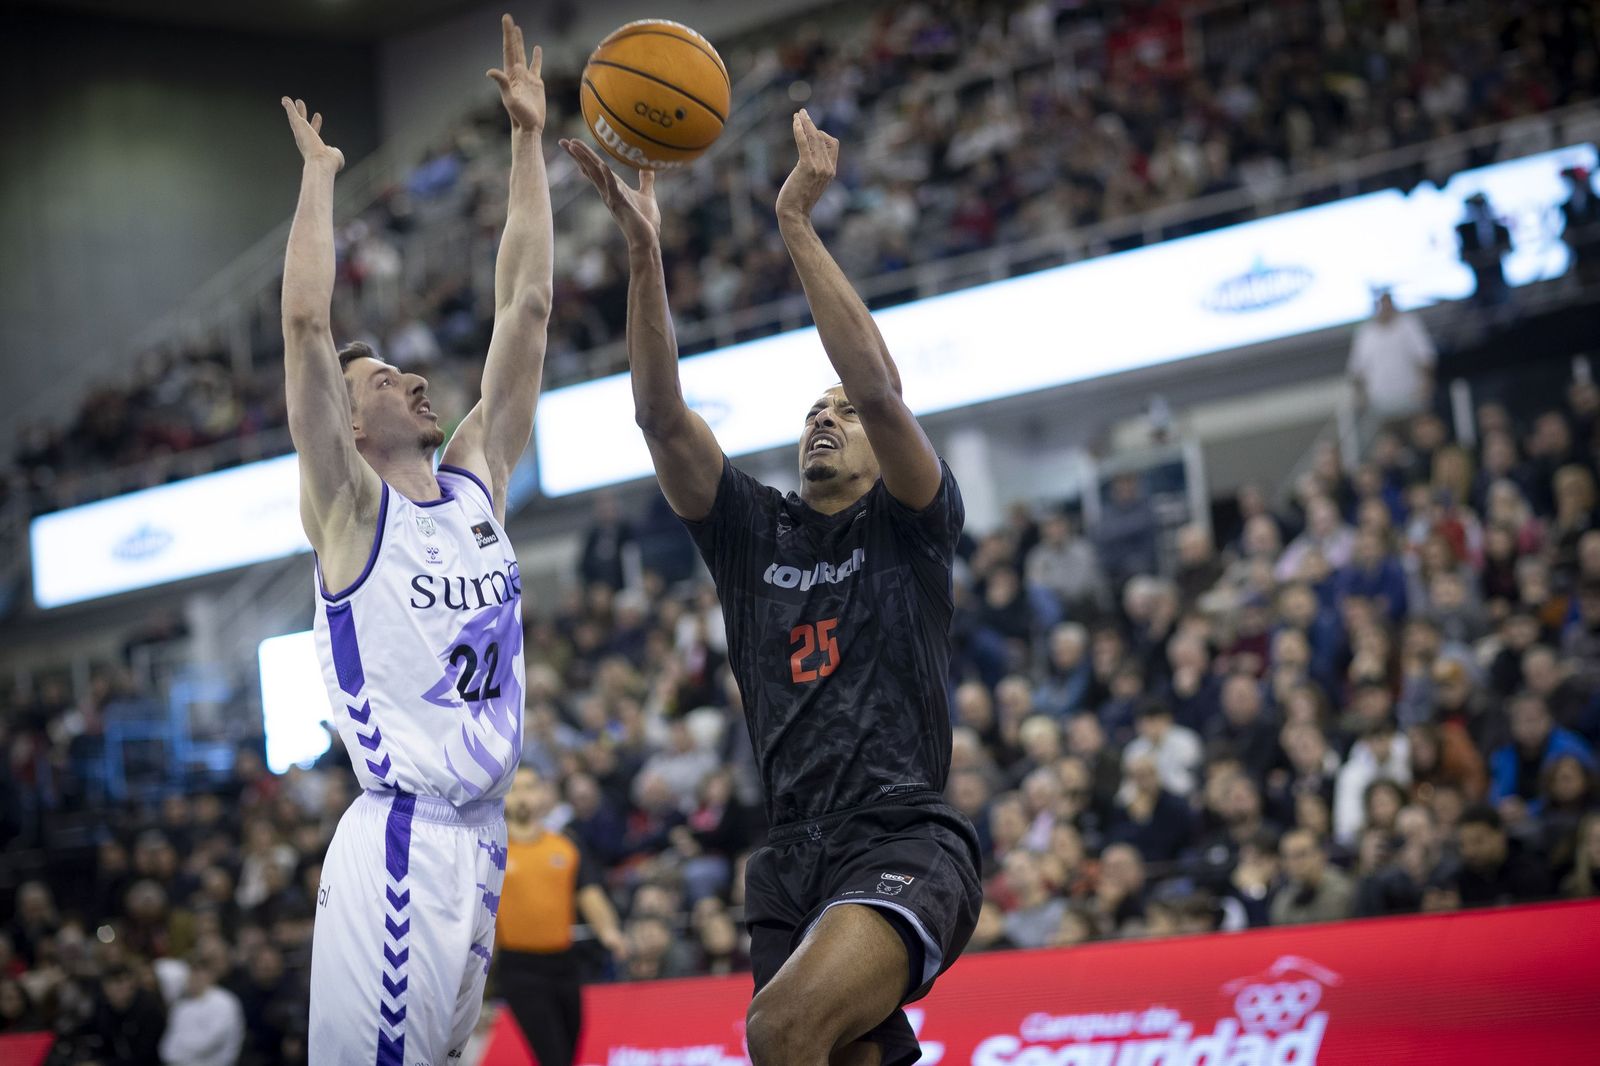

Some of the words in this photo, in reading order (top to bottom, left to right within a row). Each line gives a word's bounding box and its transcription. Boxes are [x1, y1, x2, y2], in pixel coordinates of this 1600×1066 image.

[634, 102, 673, 128] acb
[449, 643, 502, 702] 22
[790, 617, 841, 683] 25
